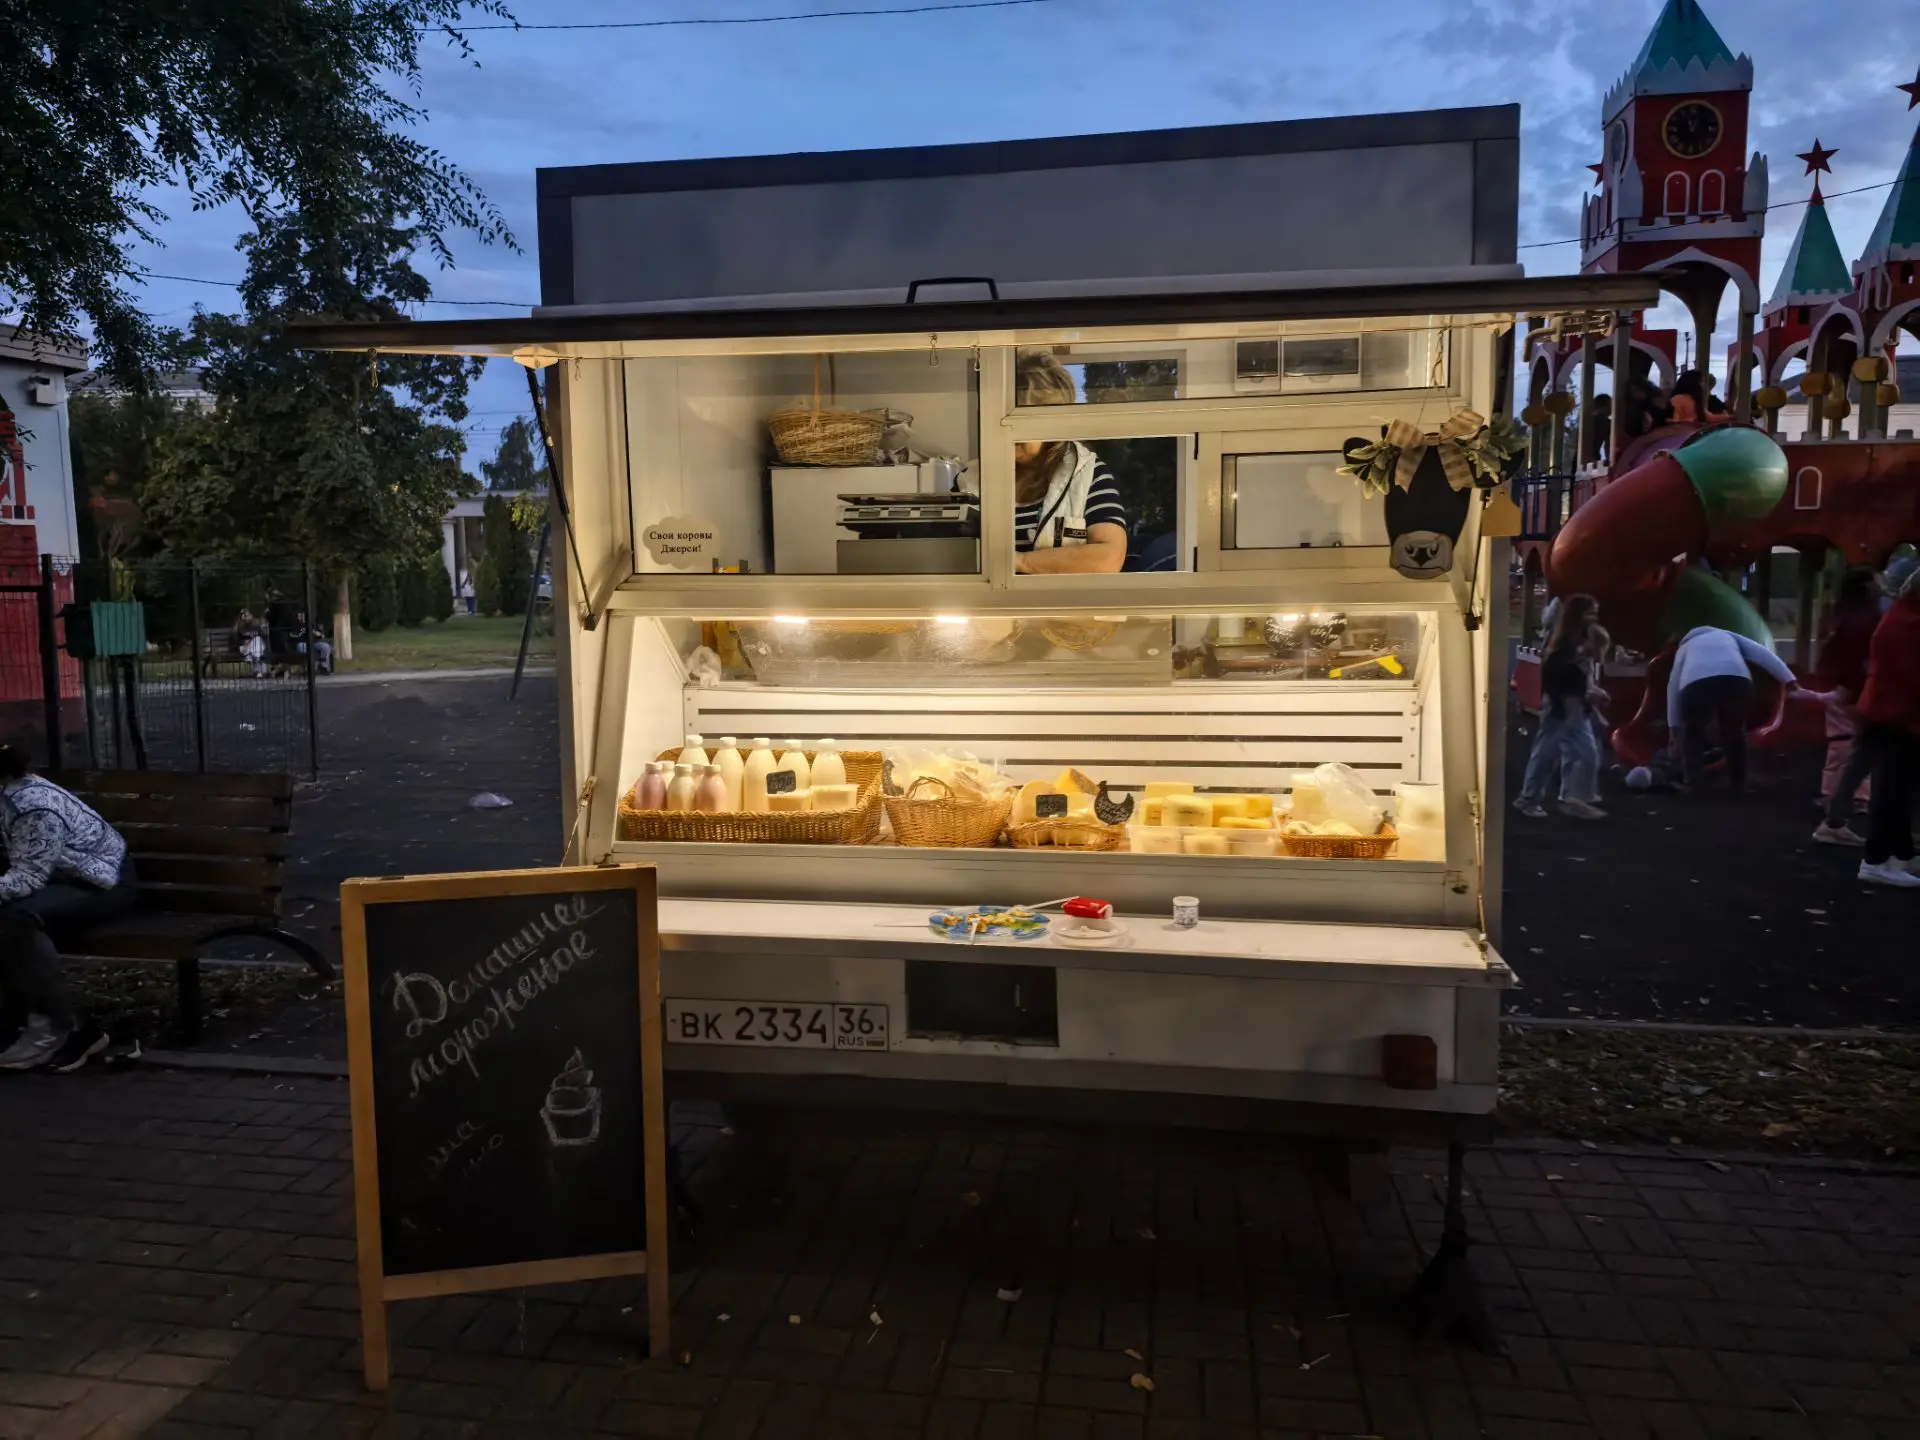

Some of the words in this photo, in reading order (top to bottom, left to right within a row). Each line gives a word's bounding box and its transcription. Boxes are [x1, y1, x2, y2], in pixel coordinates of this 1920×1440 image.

[649, 531, 674, 540] Свои
[677, 532, 713, 541] коровы
[660, 544, 702, 555] Джерси!
[391, 893, 606, 1038] Домашнее
[409, 929, 598, 1099] мороженое
[734, 1006, 827, 1044] 2334
[838, 1007, 875, 1035] 36
[837, 1036, 865, 1047] RUS
